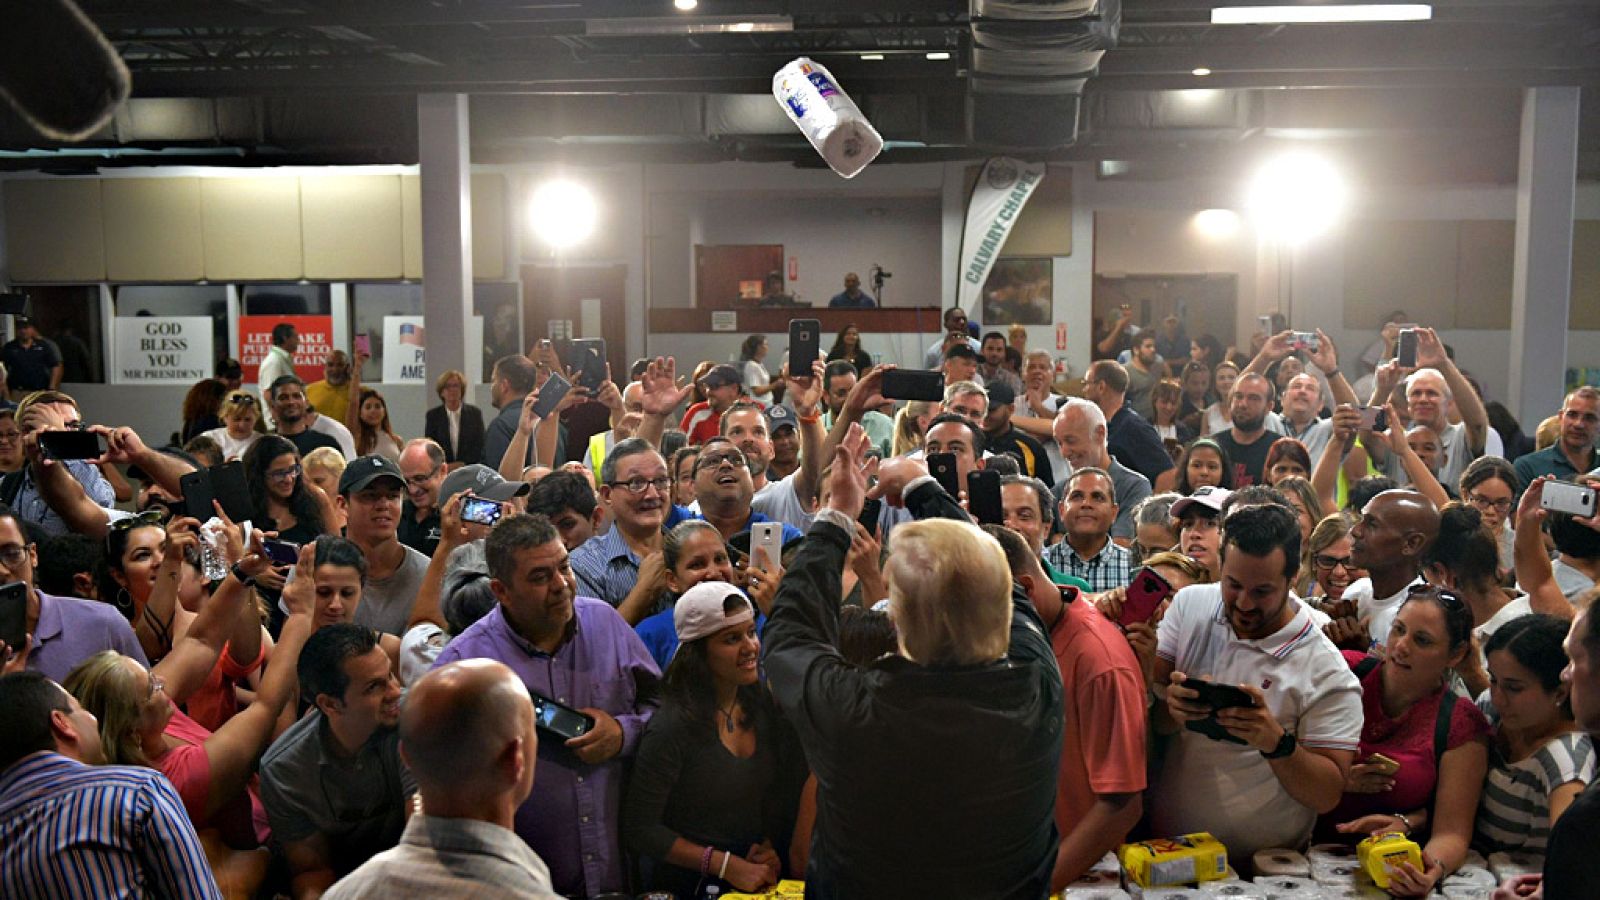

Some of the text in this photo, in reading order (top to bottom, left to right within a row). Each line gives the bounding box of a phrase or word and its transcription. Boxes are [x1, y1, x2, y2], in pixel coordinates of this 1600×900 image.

[965, 169, 1039, 284] CALVARY CHAPEL
[146, 322, 182, 336] GOD
[247, 333, 326, 343] LET AKE
[141, 338, 188, 351] BLESS
[296, 344, 330, 354] RICO
[148, 353, 180, 367] YOU
[293, 356, 327, 366] GAIN
[144, 369, 204, 379] PRESIDENT
